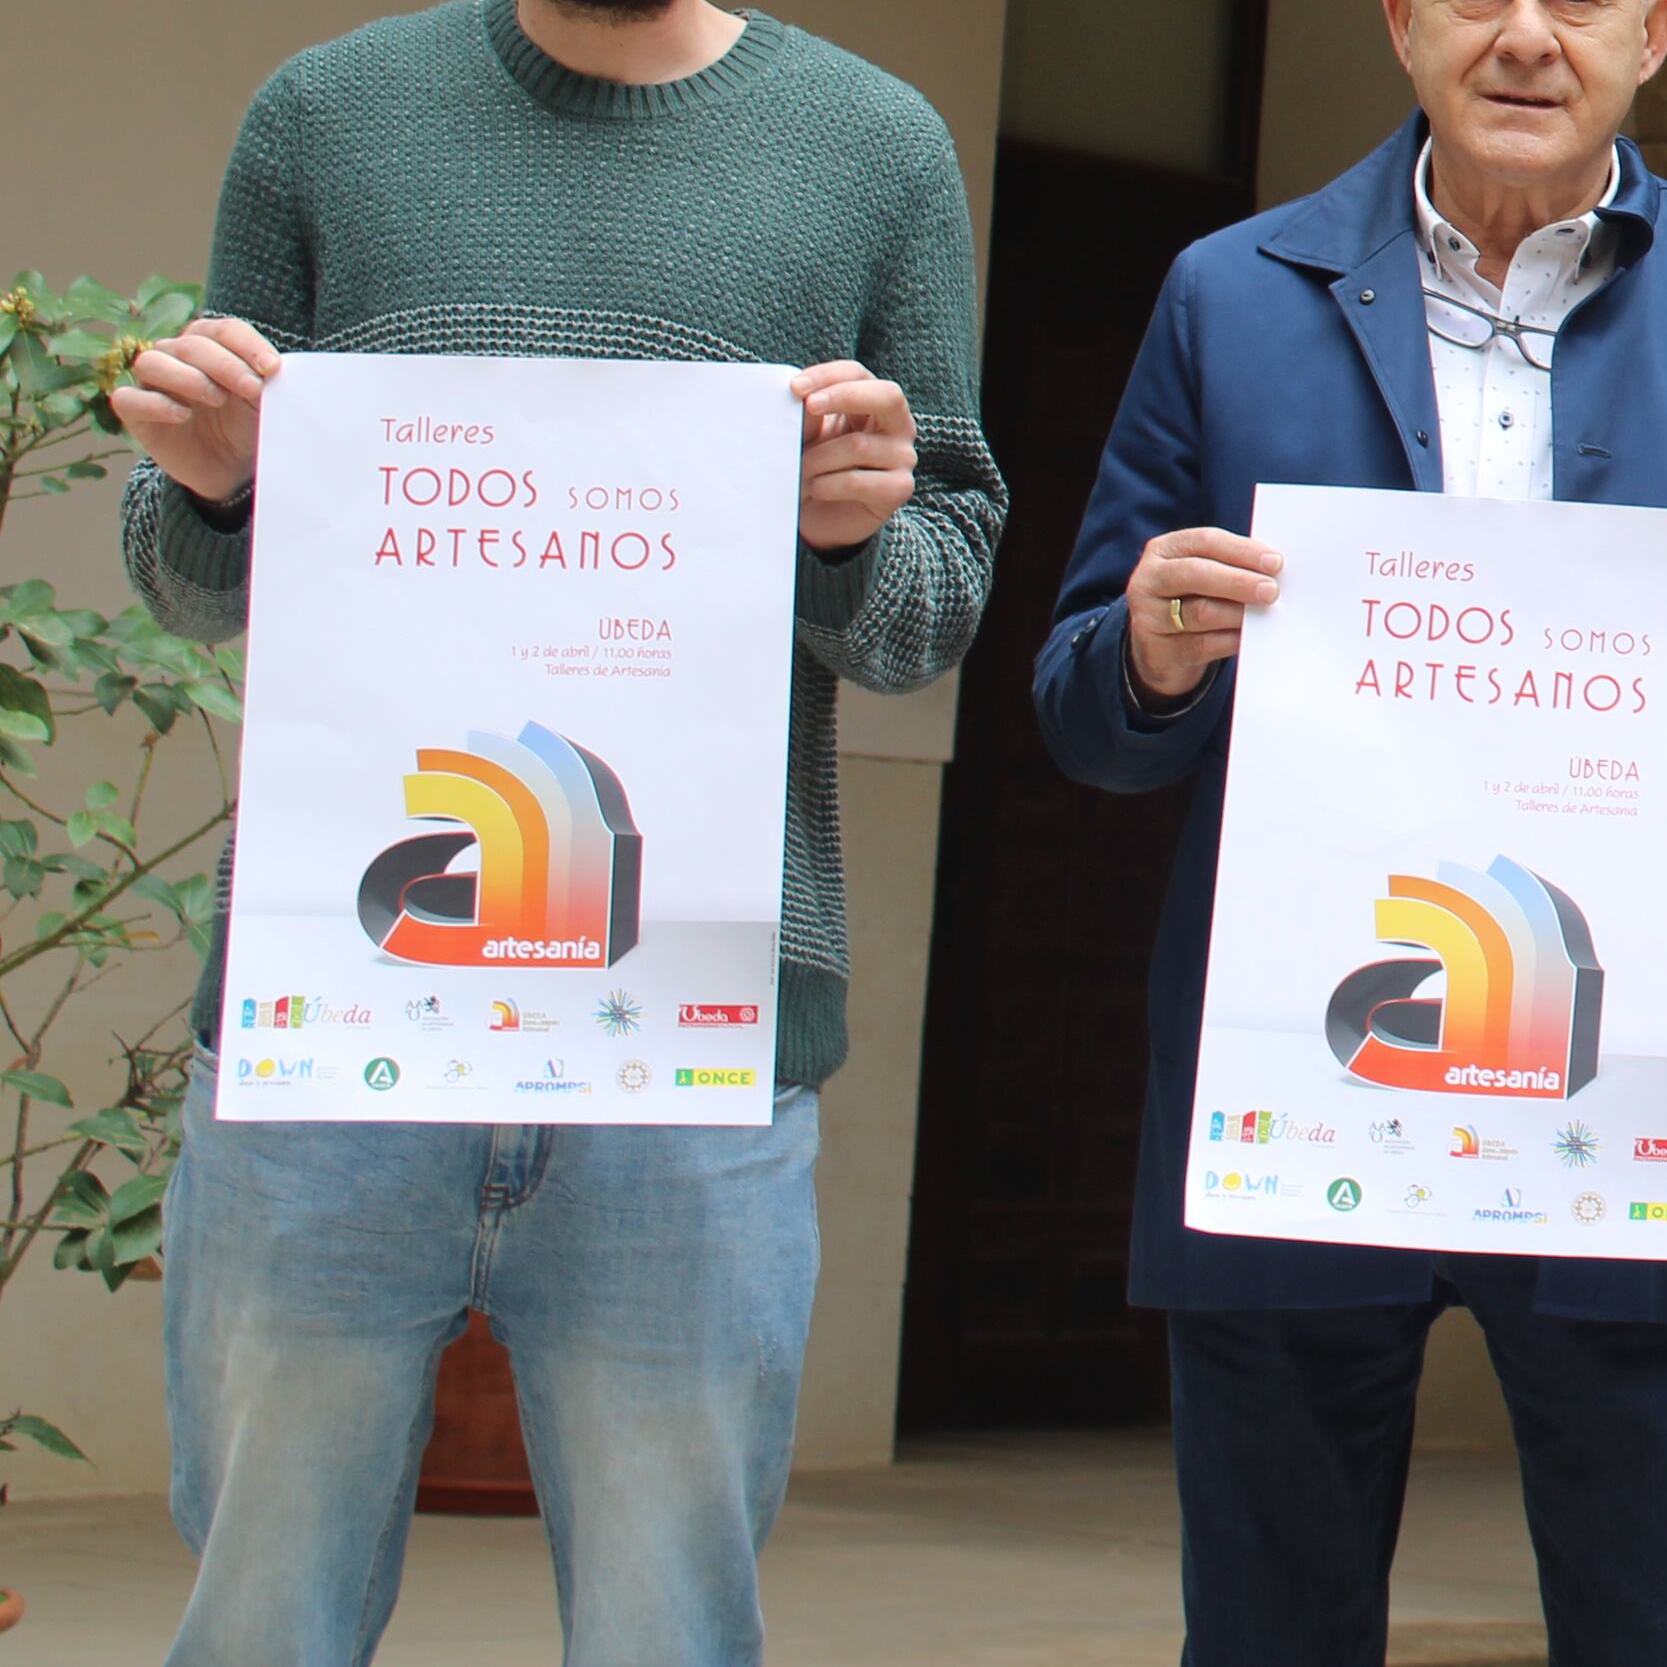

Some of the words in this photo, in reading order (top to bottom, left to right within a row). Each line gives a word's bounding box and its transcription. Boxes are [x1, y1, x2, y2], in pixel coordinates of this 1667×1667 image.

[381, 416, 494, 444] Talleres
[378, 466, 537, 508] TODOS
[568, 486, 679, 511] SOMOS
[374, 527, 676, 570] ARTESANOS
[1365, 551, 1474, 582] Talleres
[1361, 599, 1513, 646] TODOS
[1544, 627, 1650, 656] SOMOS
[521, 648, 529, 661] y
[532, 646, 539, 657] 2
[543, 645, 558, 658] de
[561, 646, 590, 658] abril
[545, 663, 590, 676] Talleres
[593, 665, 609, 676] de
[1355, 659, 1646, 713] ARTESANOS
[1492, 784, 1500, 795] y
[1504, 782, 1511, 792] 2
[1514, 782, 1530, 794] de
[1532, 783, 1560, 794] abril
[1516, 800, 1559, 813] Talleres
[1562, 802, 1577, 814] de
[482, 936, 601, 960] artesanía
[303, 996, 372, 1024] Úbeda
[698, 1072, 751, 1085] ONCE
[1444, 1064, 1560, 1090] artesanía
[1269, 1113, 1336, 1144] Úbeda
